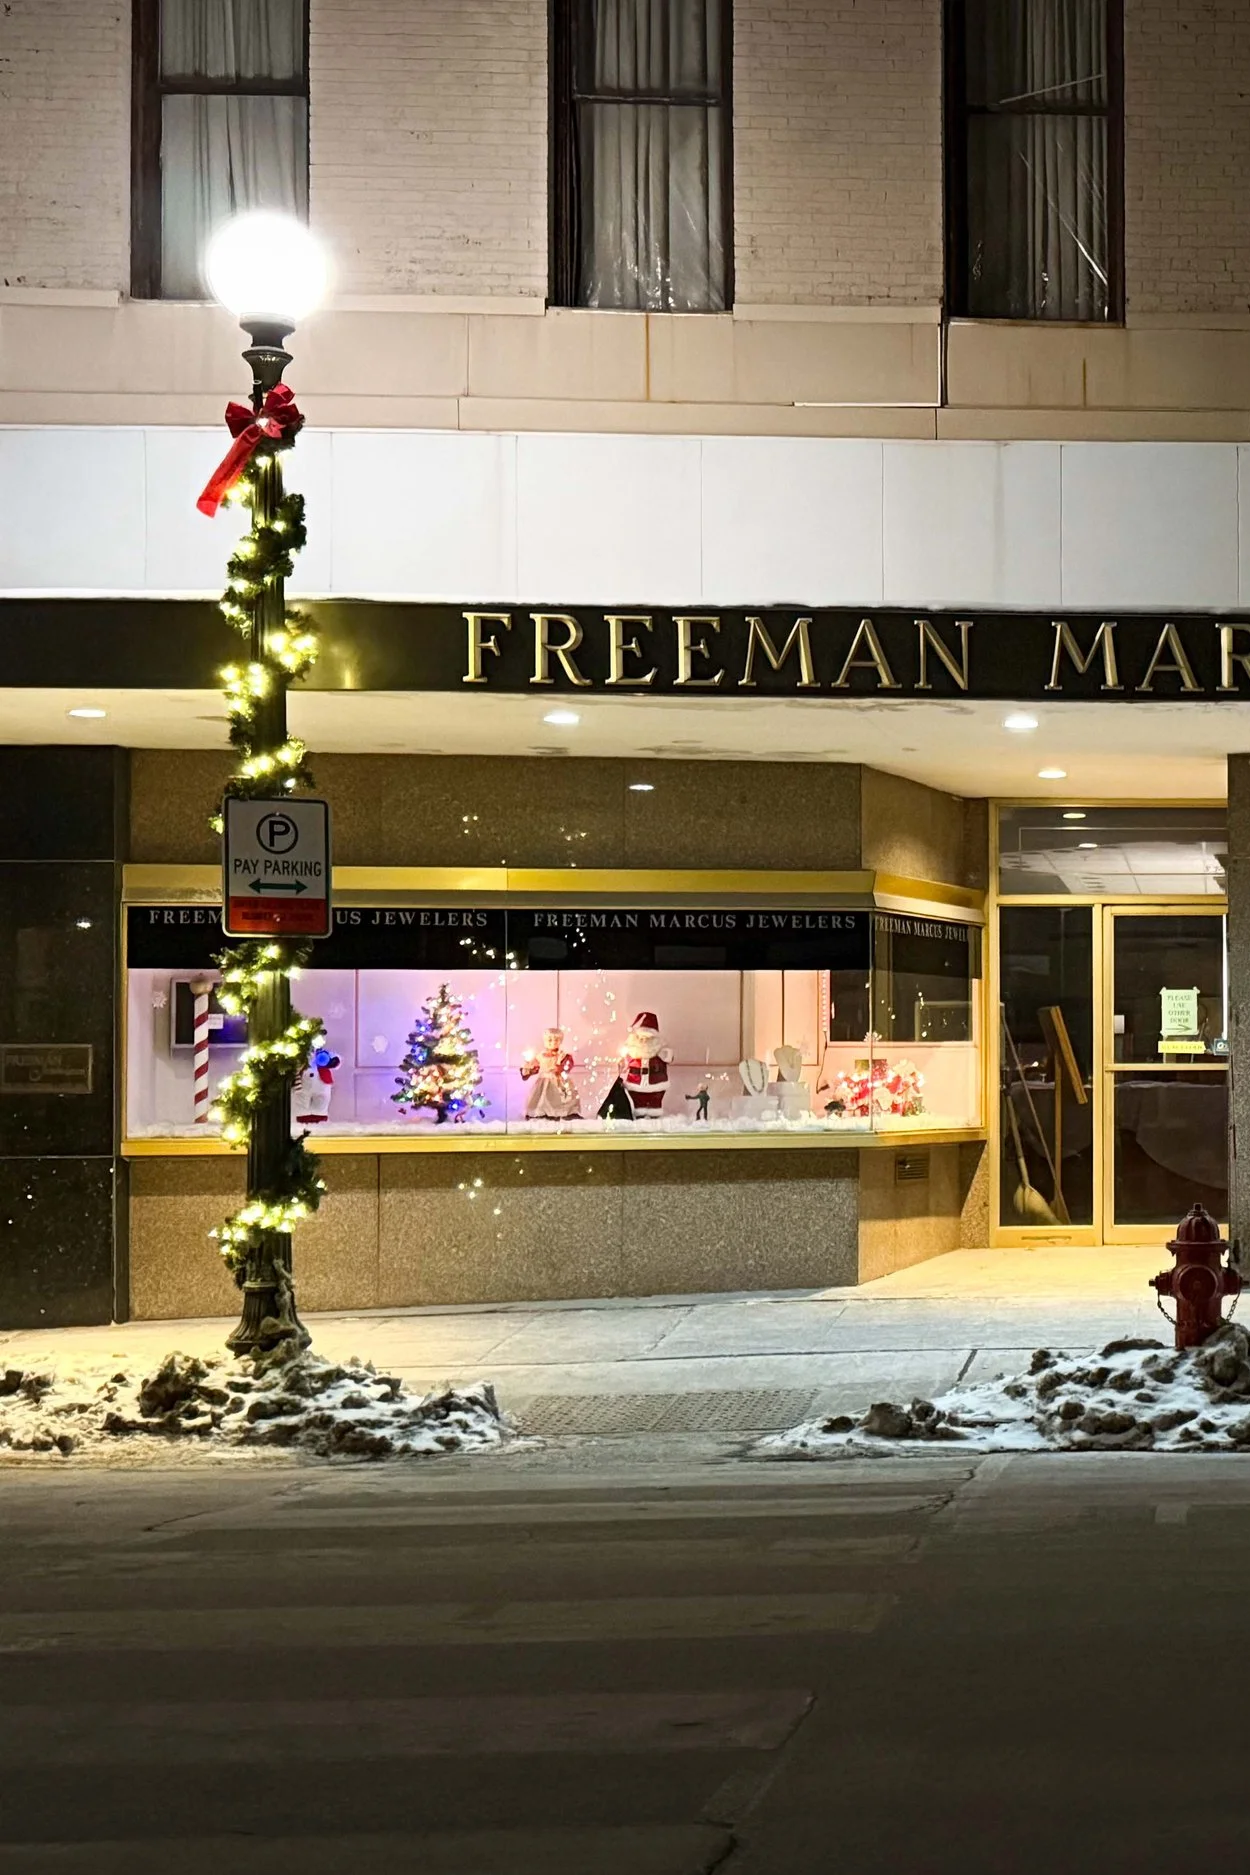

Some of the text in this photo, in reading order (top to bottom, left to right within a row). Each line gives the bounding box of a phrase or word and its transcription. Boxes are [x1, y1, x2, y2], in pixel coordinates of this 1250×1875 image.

[461, 610, 974, 691] FREEMAN
[268, 819, 291, 847] P
[233, 858, 322, 877] PAY PARKING
[149, 909, 223, 924] FREEM
[371, 911, 488, 927] JEWELERS
[533, 912, 856, 929] FREEMAN MARCUS JEWELERS
[913, 920, 943, 939] MARCUS
